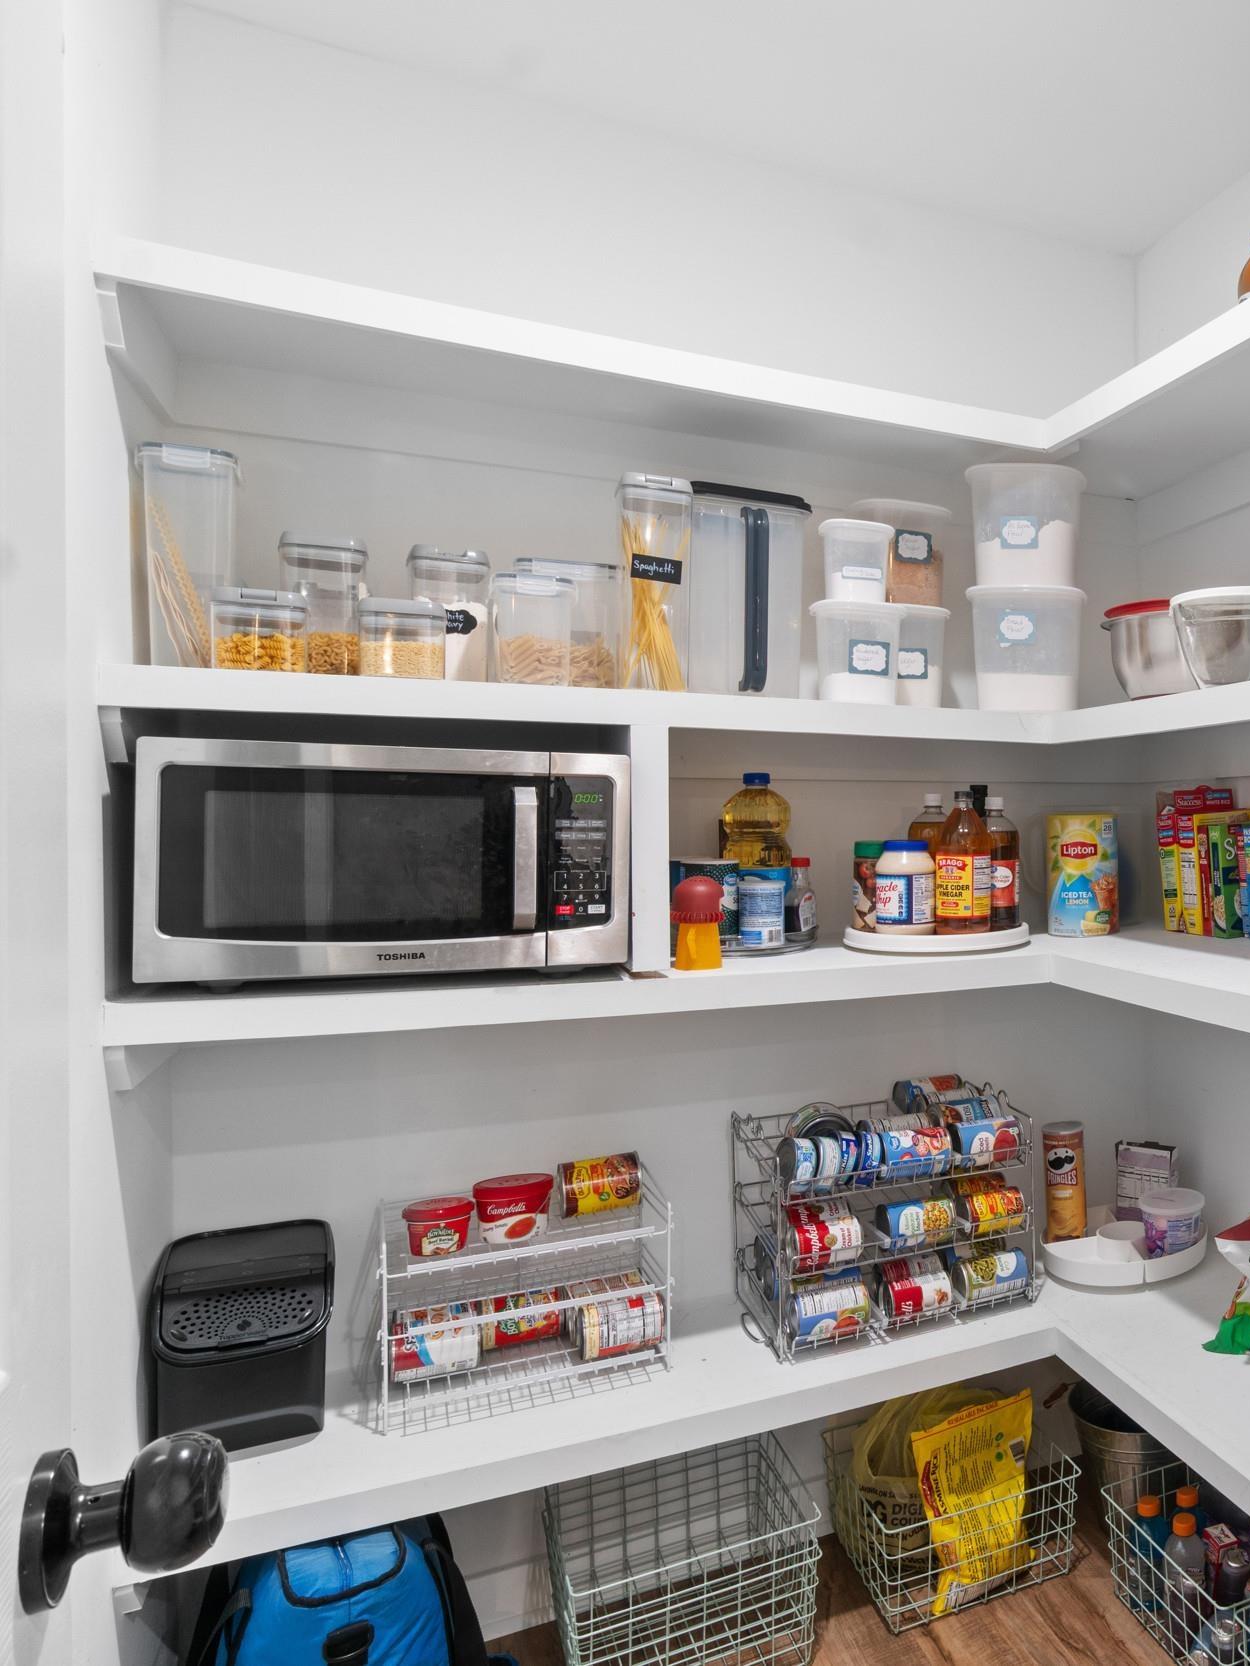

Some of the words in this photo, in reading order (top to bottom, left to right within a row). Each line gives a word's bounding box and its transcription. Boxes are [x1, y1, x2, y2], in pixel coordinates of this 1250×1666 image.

[633, 559, 675, 576] Spaghetti
[447, 612, 464, 622] hite
[1063, 846, 1095, 857] Lipton
[938, 858, 963, 868] BRAGG
[876, 882, 898, 893] racle
[936, 884, 950, 892] PPLE
[950, 884, 970, 892] CIDER
[1061, 891, 1078, 899] ICED
[377, 952, 426, 961] TOSHIBA
[1047, 1170, 1077, 1186] PRINGLES
[487, 1202, 526, 1216] Campbell's
[930, 1471, 950, 1515] ASMINE
[892, 1504, 923, 1516] DIGI
